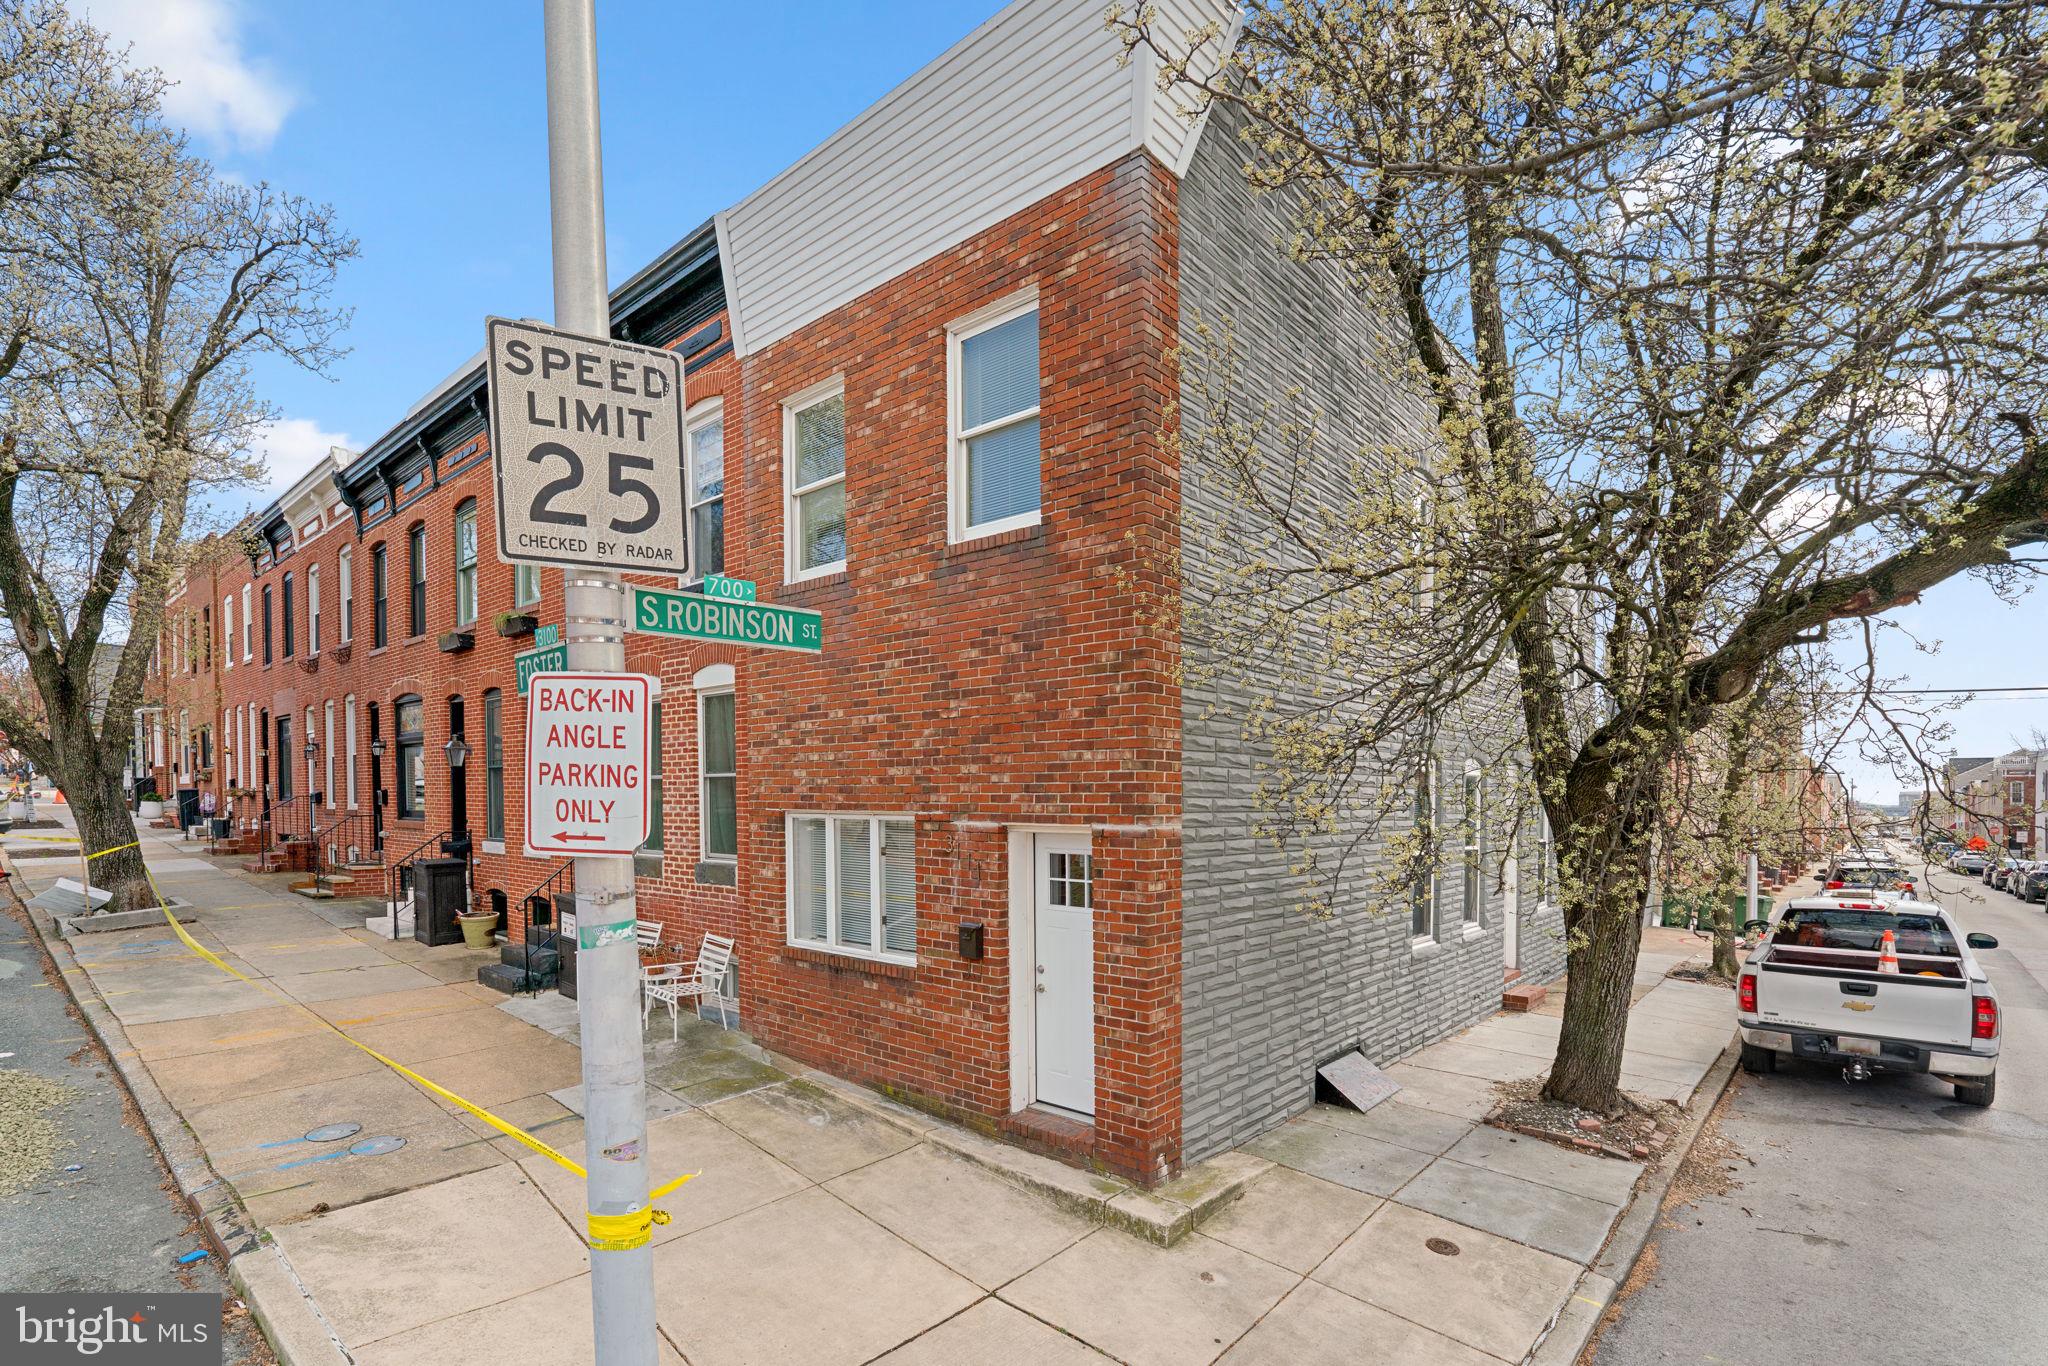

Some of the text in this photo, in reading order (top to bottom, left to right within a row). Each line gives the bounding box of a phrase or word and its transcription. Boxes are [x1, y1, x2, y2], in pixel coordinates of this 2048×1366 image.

[504, 339, 671, 399] SPEED
[526, 390, 653, 442] LIMIT
[526, 441, 661, 535] 25
[518, 533, 674, 561] CHECKED BY RADAR
[708, 577, 744, 599] 700
[537, 626, 557, 646] 3100
[539, 687, 635, 713] BACK-IN
[546, 723, 627, 749] ANGLE
[538, 762, 639, 789] PARKING
[555, 798, 616, 824] ONLY
